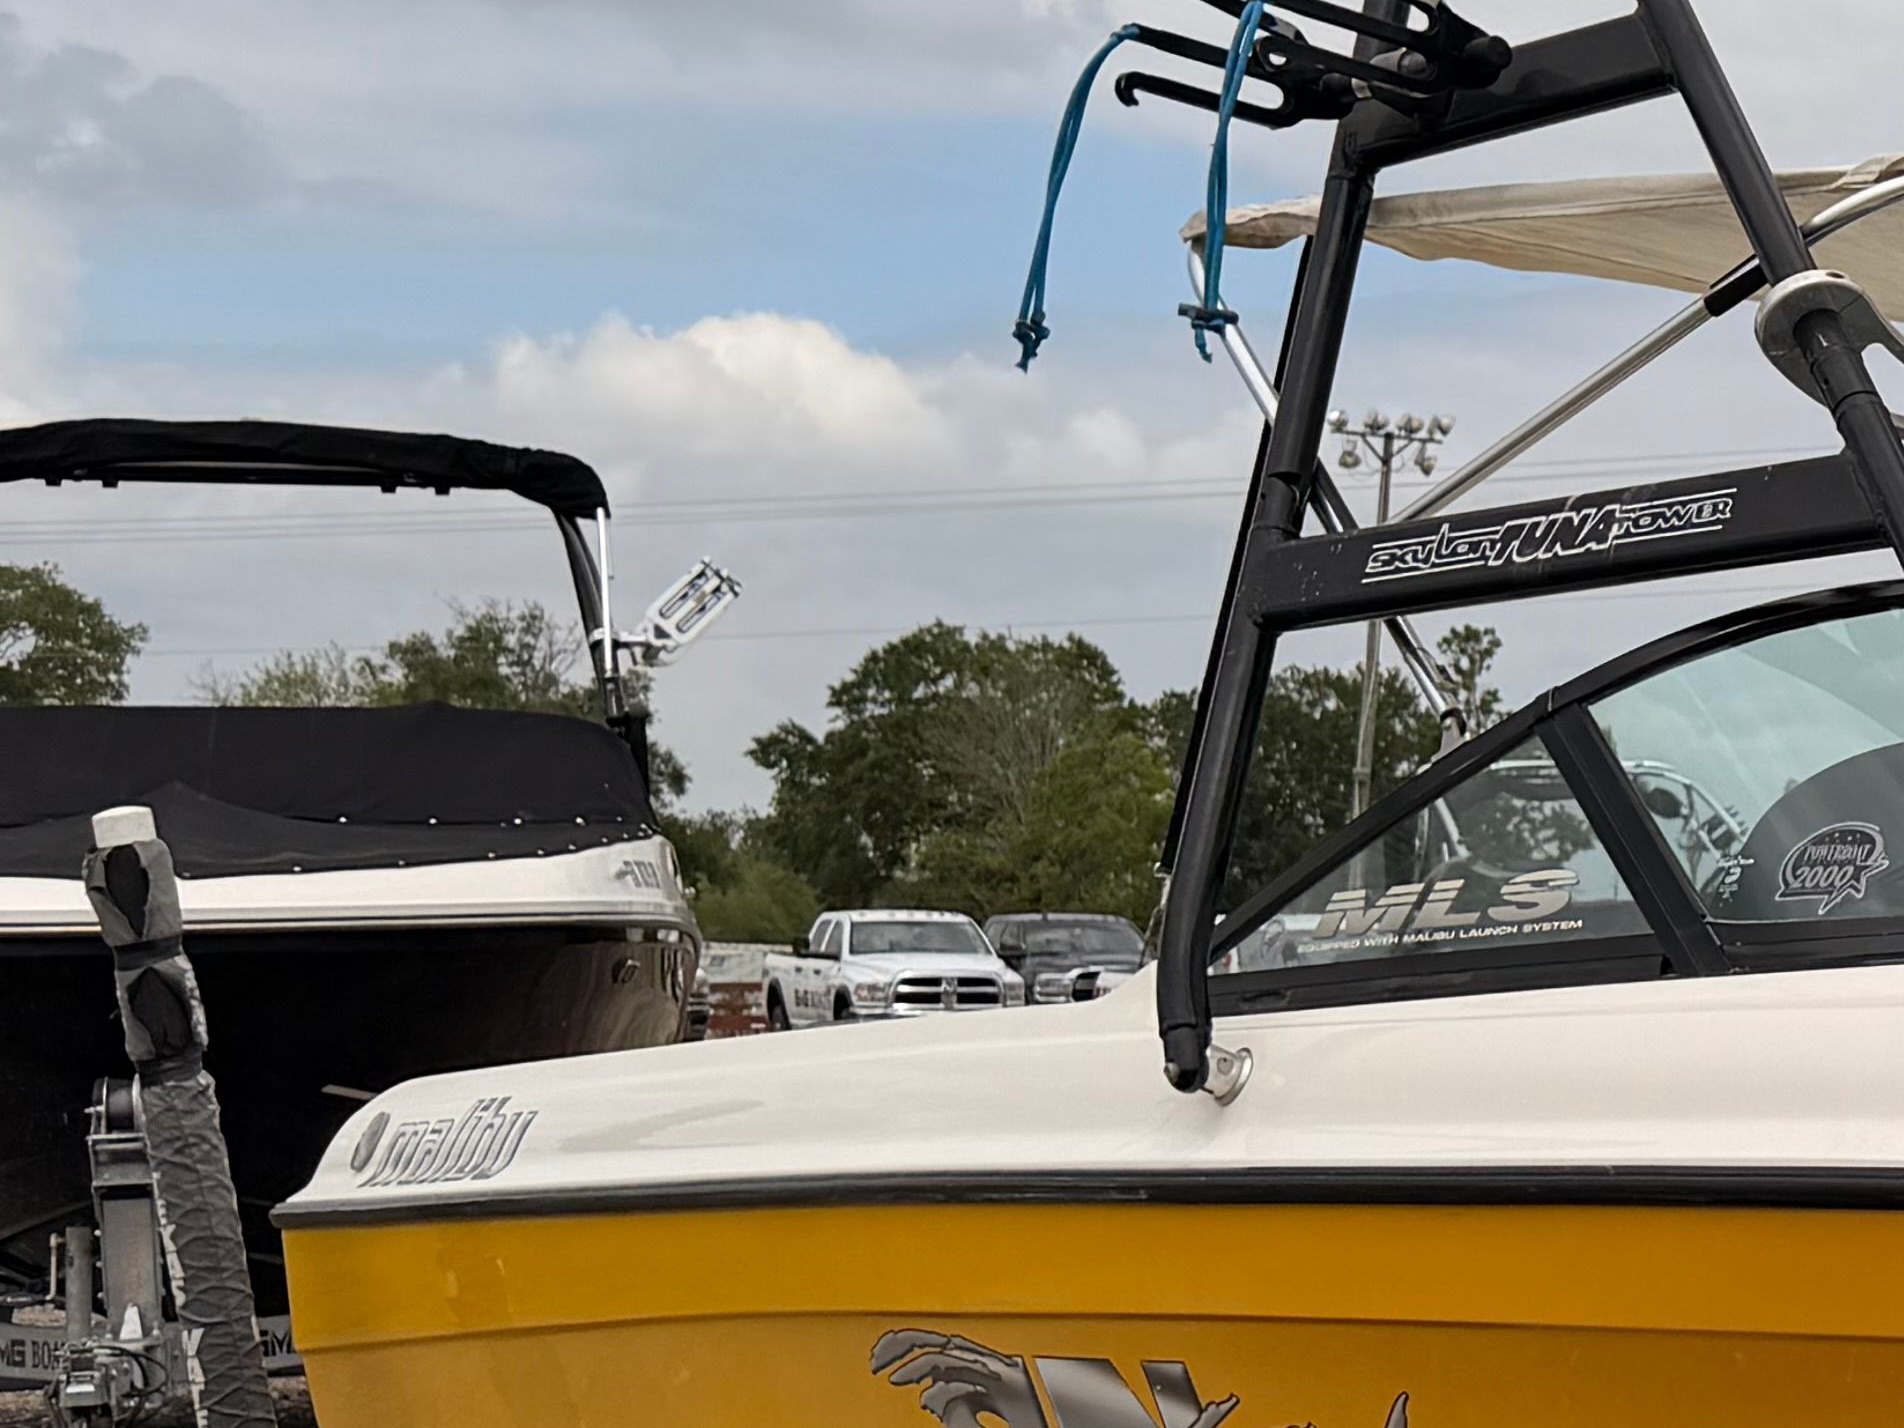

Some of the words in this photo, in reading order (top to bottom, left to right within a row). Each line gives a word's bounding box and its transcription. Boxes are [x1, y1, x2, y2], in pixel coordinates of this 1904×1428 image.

[1792, 865, 1855, 888] 2000
[1312, 869, 1580, 939] MLS
[1297, 940, 1361, 954] EQUIPPED
[1364, 934, 1399, 948] WITH
[1402, 930, 1455, 944] MALIBU
[1459, 924, 1518, 939] LAUNCH
[1522, 919, 1584, 935] SYSTEM
[357, 1095, 539, 1188] malibu
